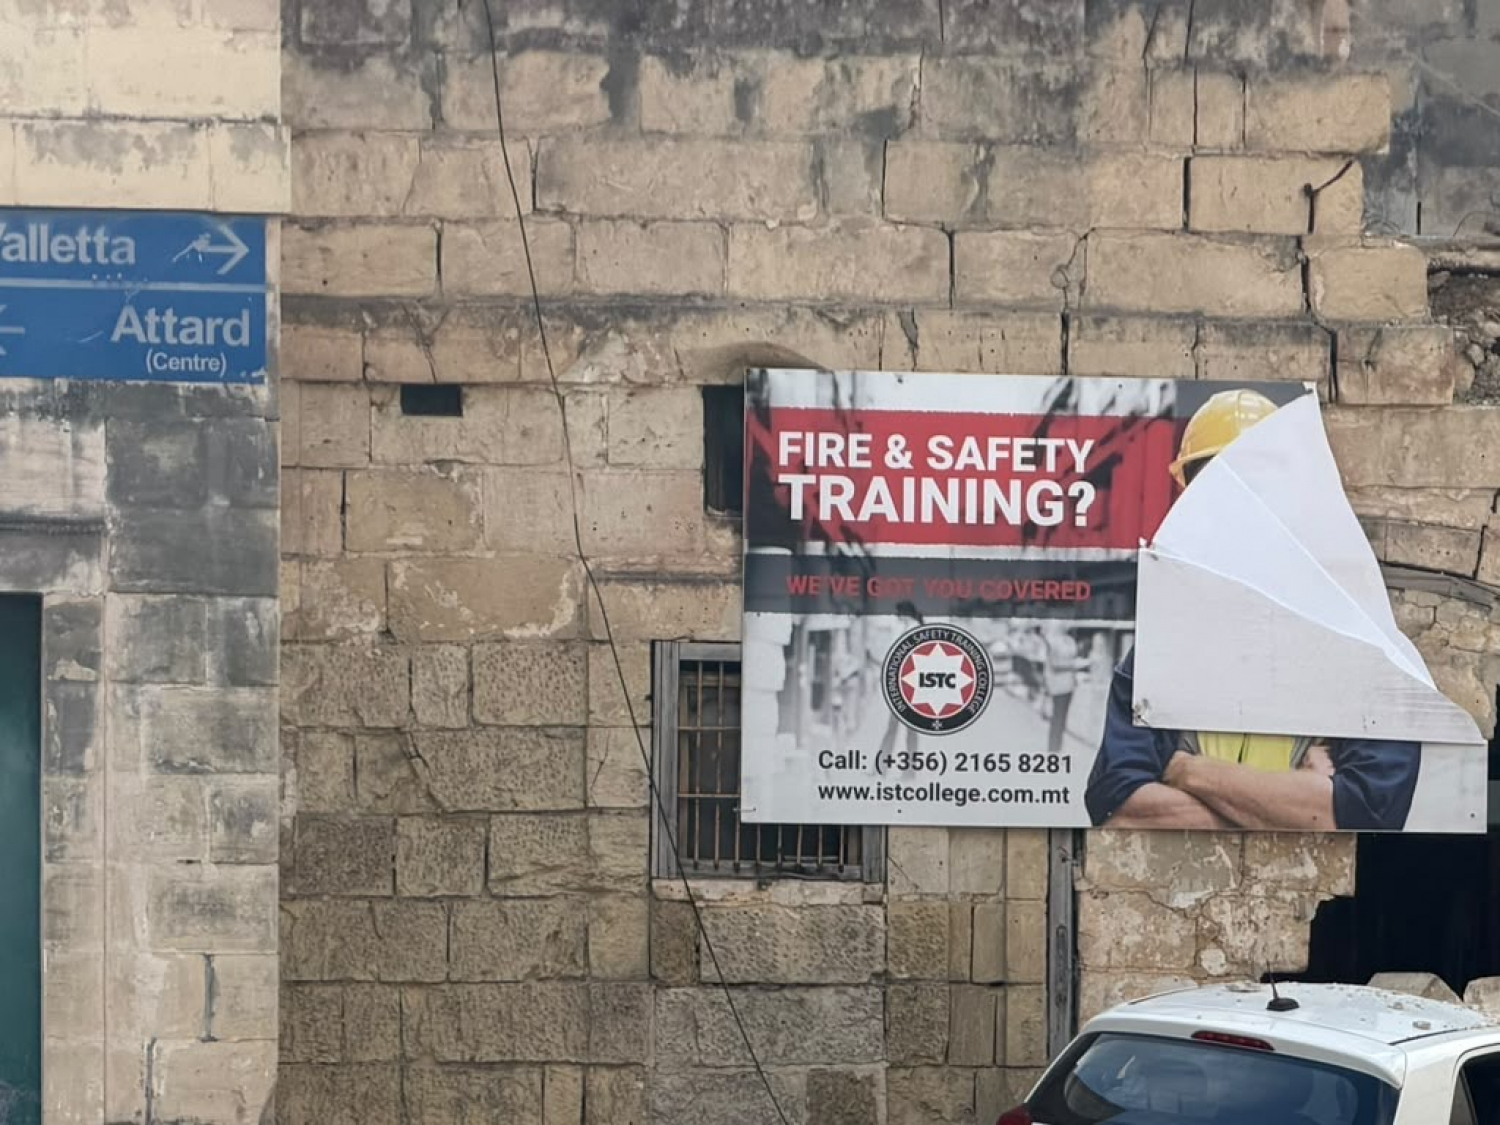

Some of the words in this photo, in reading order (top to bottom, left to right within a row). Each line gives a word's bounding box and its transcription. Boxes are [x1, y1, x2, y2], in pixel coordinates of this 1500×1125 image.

[0, 222, 136, 265] alletta
[110, 305, 250, 346] Attard
[145, 349, 227, 376] (Centre)
[778, 431, 873, 468] FIRE
[884, 434, 914, 470] &
[926, 435, 1097, 474] SAFETY
[777, 473, 1097, 527] TRAINING?
[786, 575, 860, 597] WE'VE
[867, 577, 915, 597] GOT
[925, 578, 973, 599] YOU
[979, 579, 1092, 600] COVERED
[913, 629, 950, 644] SAFETY
[951, 632, 985, 670] TRAINING
[919, 672, 956, 689] ISTC
[966, 671, 988, 714] COLLEGE
[818, 750, 868, 770] Call:
[875, 750, 948, 776] (+356)
[954, 753, 1012, 773] 2165
[1018, 754, 1072, 774] 8281
[818, 782, 1070, 807] www.istcollege.com.mt
